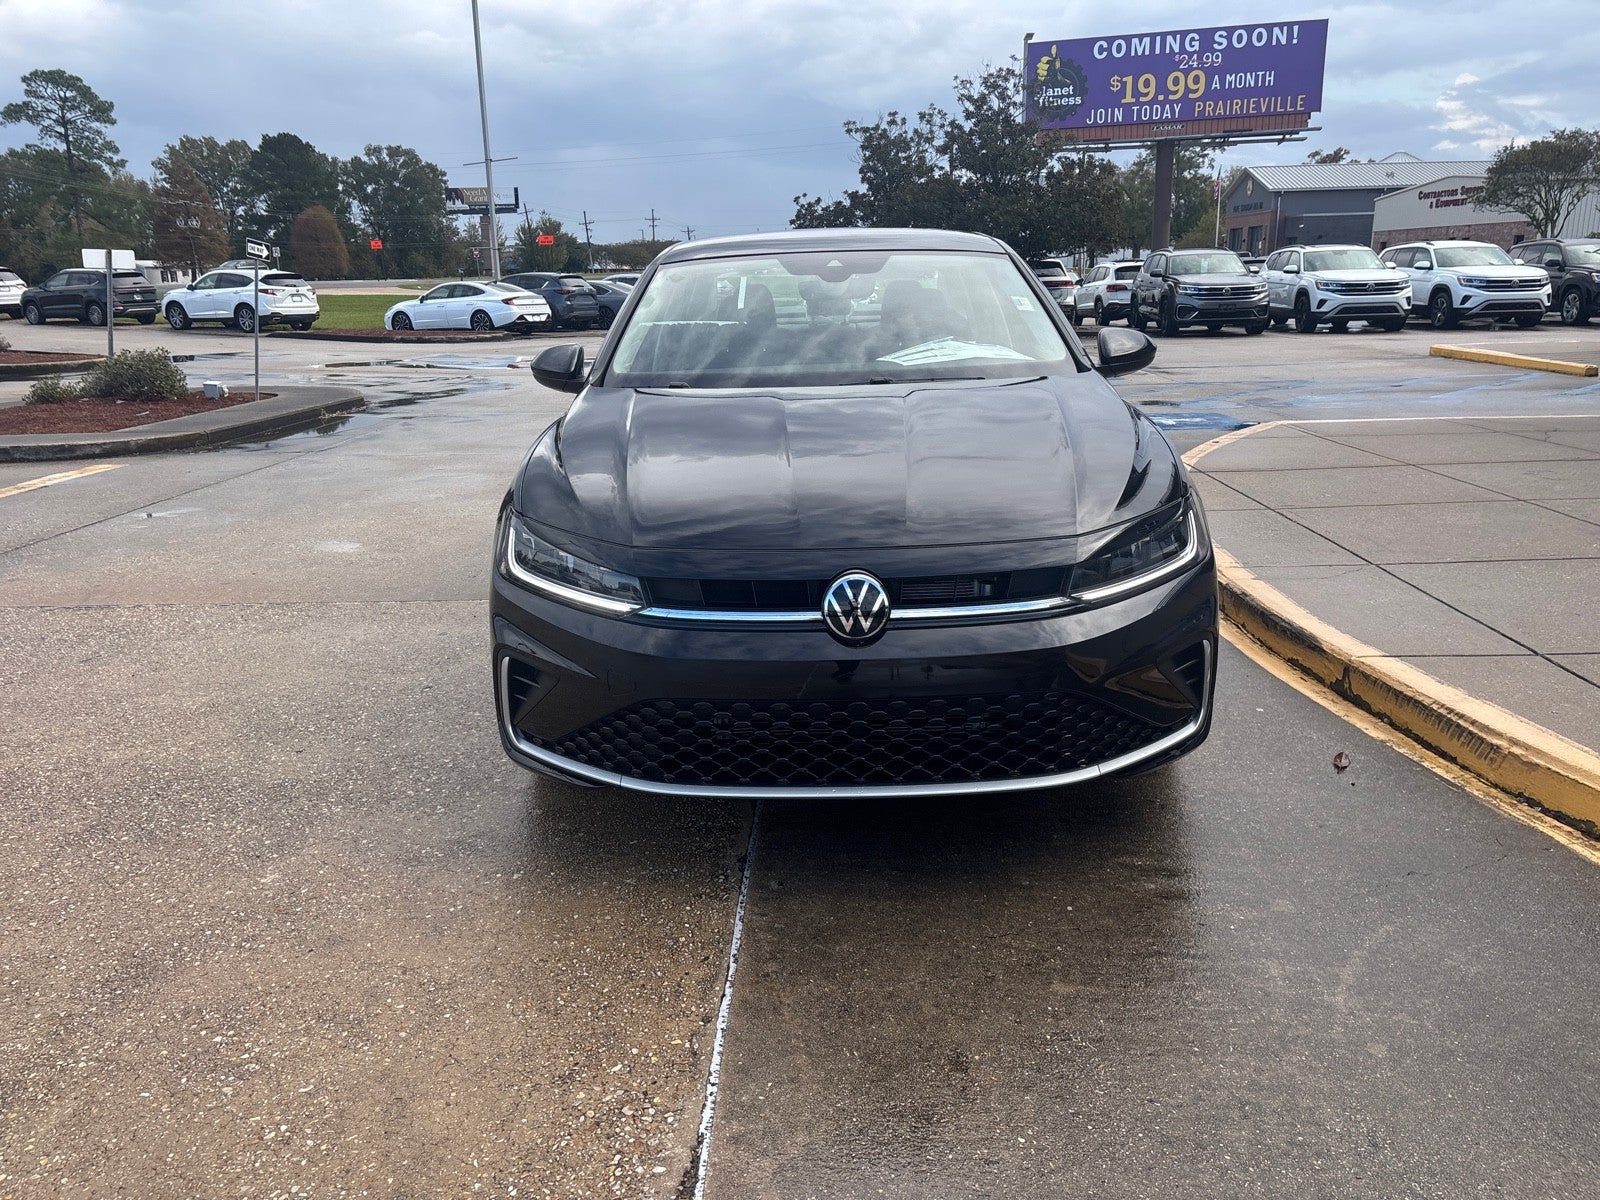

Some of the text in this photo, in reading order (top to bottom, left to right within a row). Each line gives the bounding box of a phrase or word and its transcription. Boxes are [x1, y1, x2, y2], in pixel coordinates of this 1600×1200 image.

[1092, 24, 1299, 60] COMING SOON!
[1174, 52, 1223, 69] $24.99
[1110, 69, 1206, 104] $19.99
[1211, 70, 1275, 90] A MONTH
[1034, 84, 1074, 99] lanet
[1086, 94, 1306, 125] JOIN TODAY PRAIRIEVILLE
[248, 244, 257, 252] ONE
[256, 246, 265, 254] WAY
